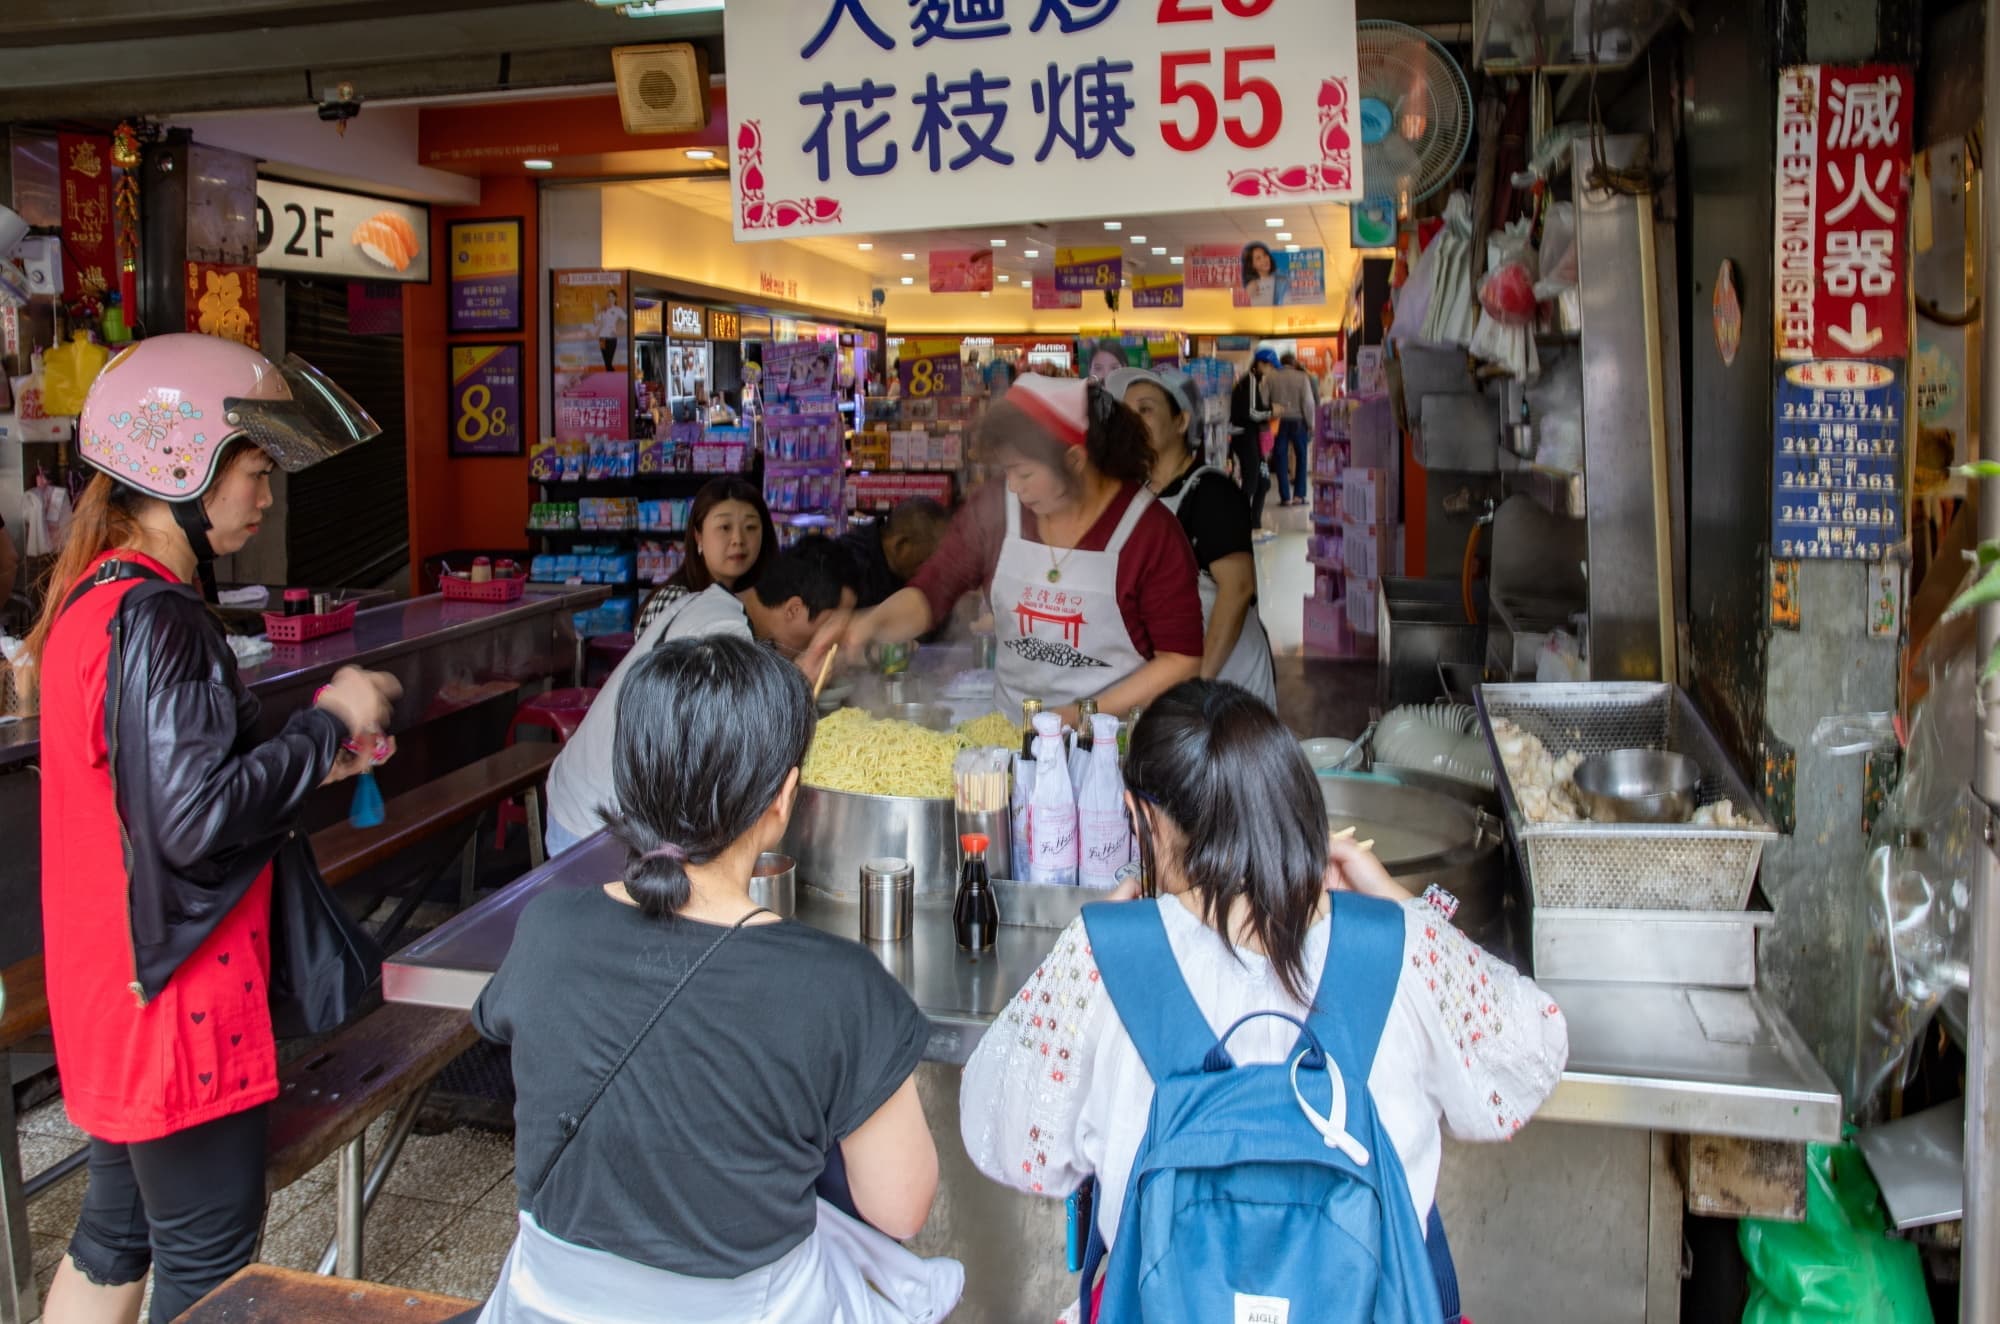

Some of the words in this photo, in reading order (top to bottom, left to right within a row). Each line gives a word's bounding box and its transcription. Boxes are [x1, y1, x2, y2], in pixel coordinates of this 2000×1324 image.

[799, 55, 1137, 182] 花枝焿
[1157, 44, 1284, 153] 55
[284, 202, 335, 258] 2F
[1823, 74, 1903, 297] 滅火器
